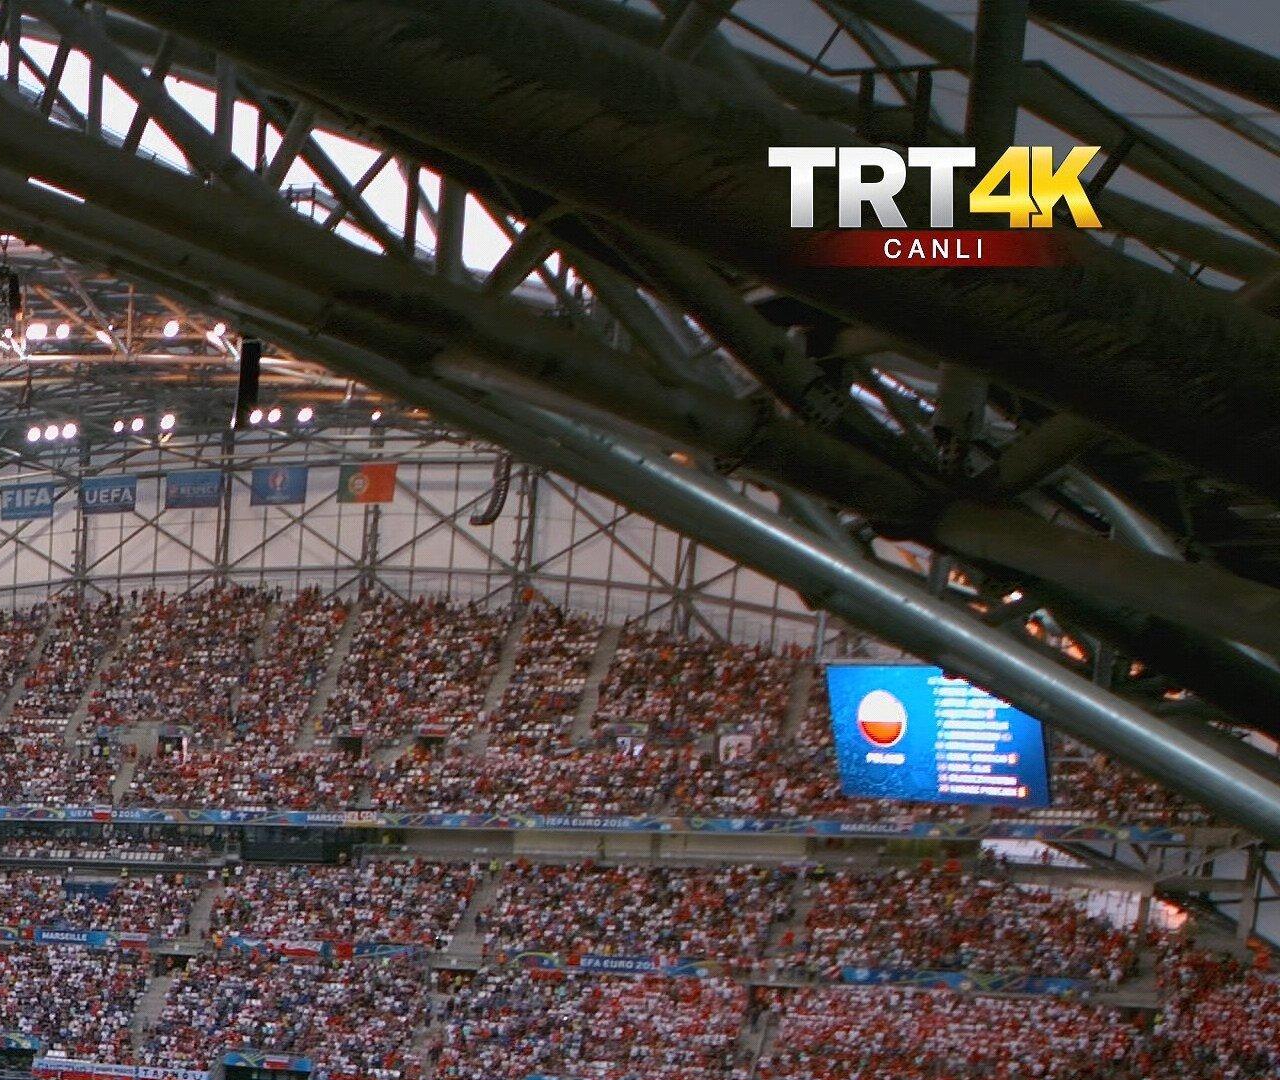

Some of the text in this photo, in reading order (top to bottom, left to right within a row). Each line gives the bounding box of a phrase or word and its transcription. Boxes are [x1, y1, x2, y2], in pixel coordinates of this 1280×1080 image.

[2, 487, 52, 510] FIFA
[85, 485, 133, 505] UEFA
[42, 932, 88, 942] MARSEILLE
[603, 959, 634, 969] EURO
